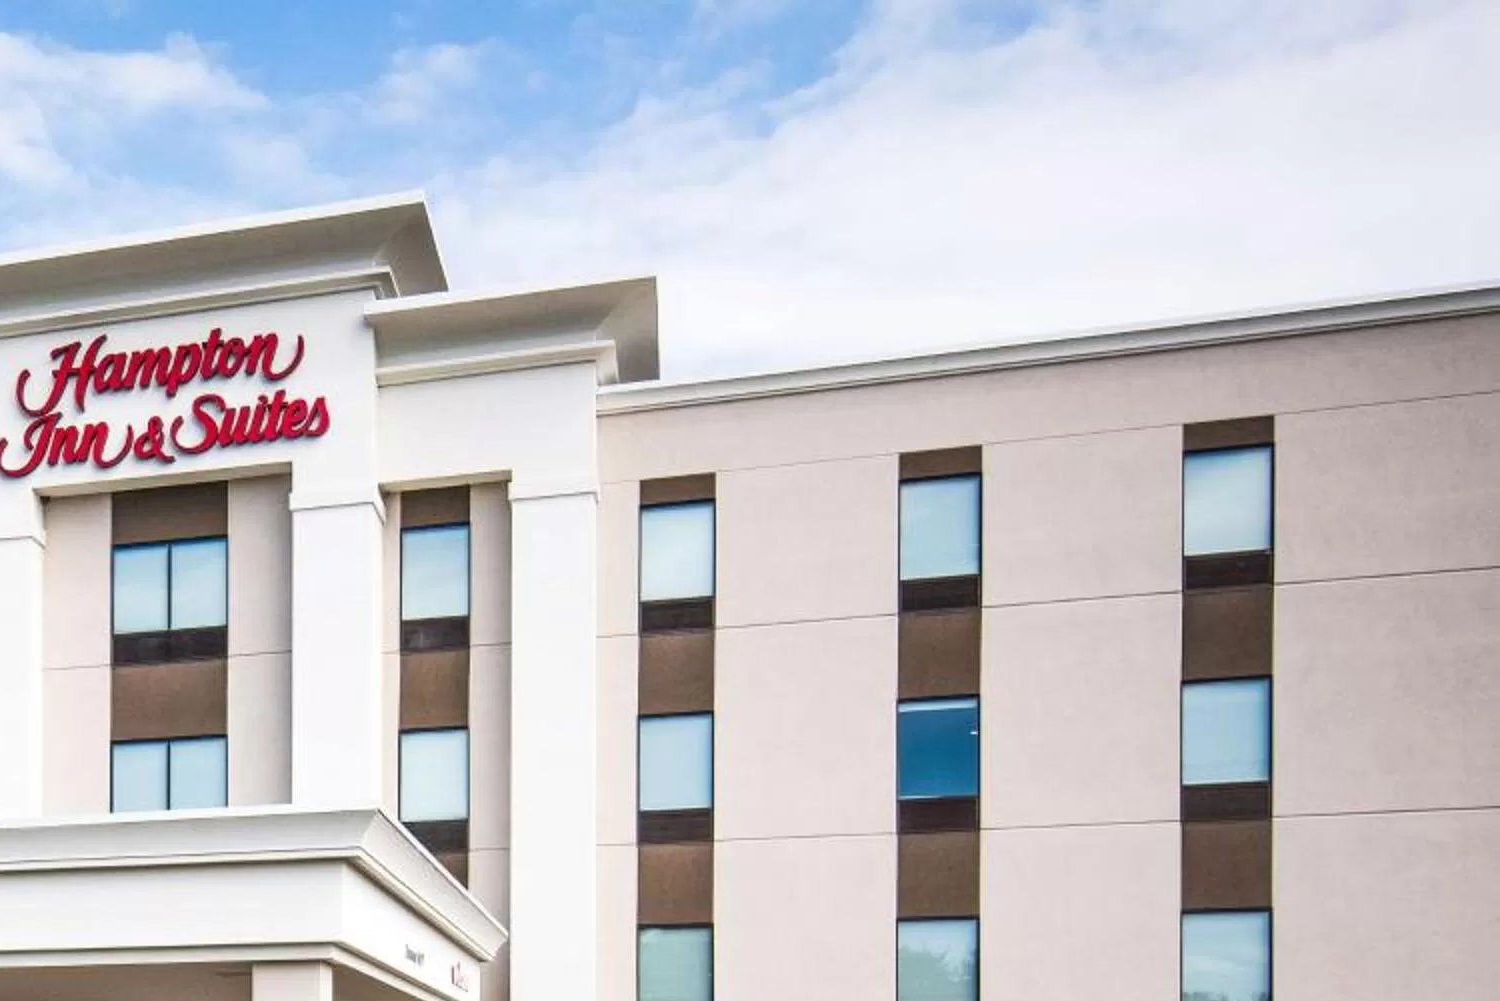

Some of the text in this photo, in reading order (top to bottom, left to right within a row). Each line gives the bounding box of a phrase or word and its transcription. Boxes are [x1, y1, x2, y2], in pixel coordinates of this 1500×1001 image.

[15, 328, 305, 417] Hampton
[133, 415, 175, 464] &
[170, 389, 330, 455] Suites
